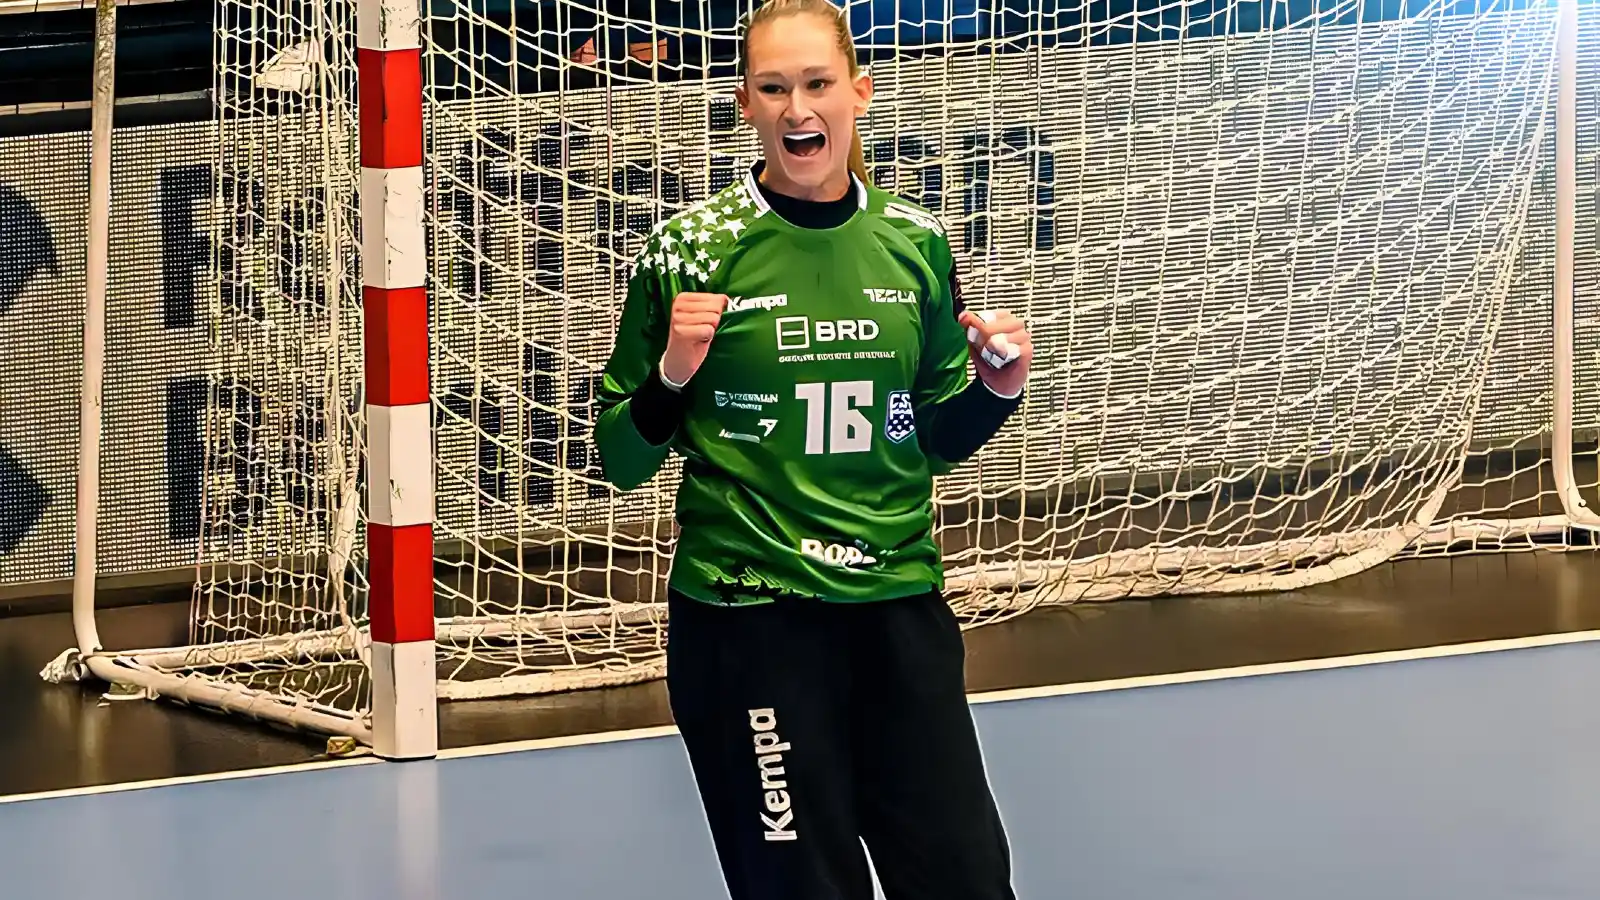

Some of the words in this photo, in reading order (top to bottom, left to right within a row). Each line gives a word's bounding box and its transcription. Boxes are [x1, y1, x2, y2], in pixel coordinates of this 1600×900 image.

[727, 294, 788, 312] Kempa
[815, 319, 880, 342] BRD
[795, 380, 873, 454] 16
[748, 708, 798, 841] Kempa
